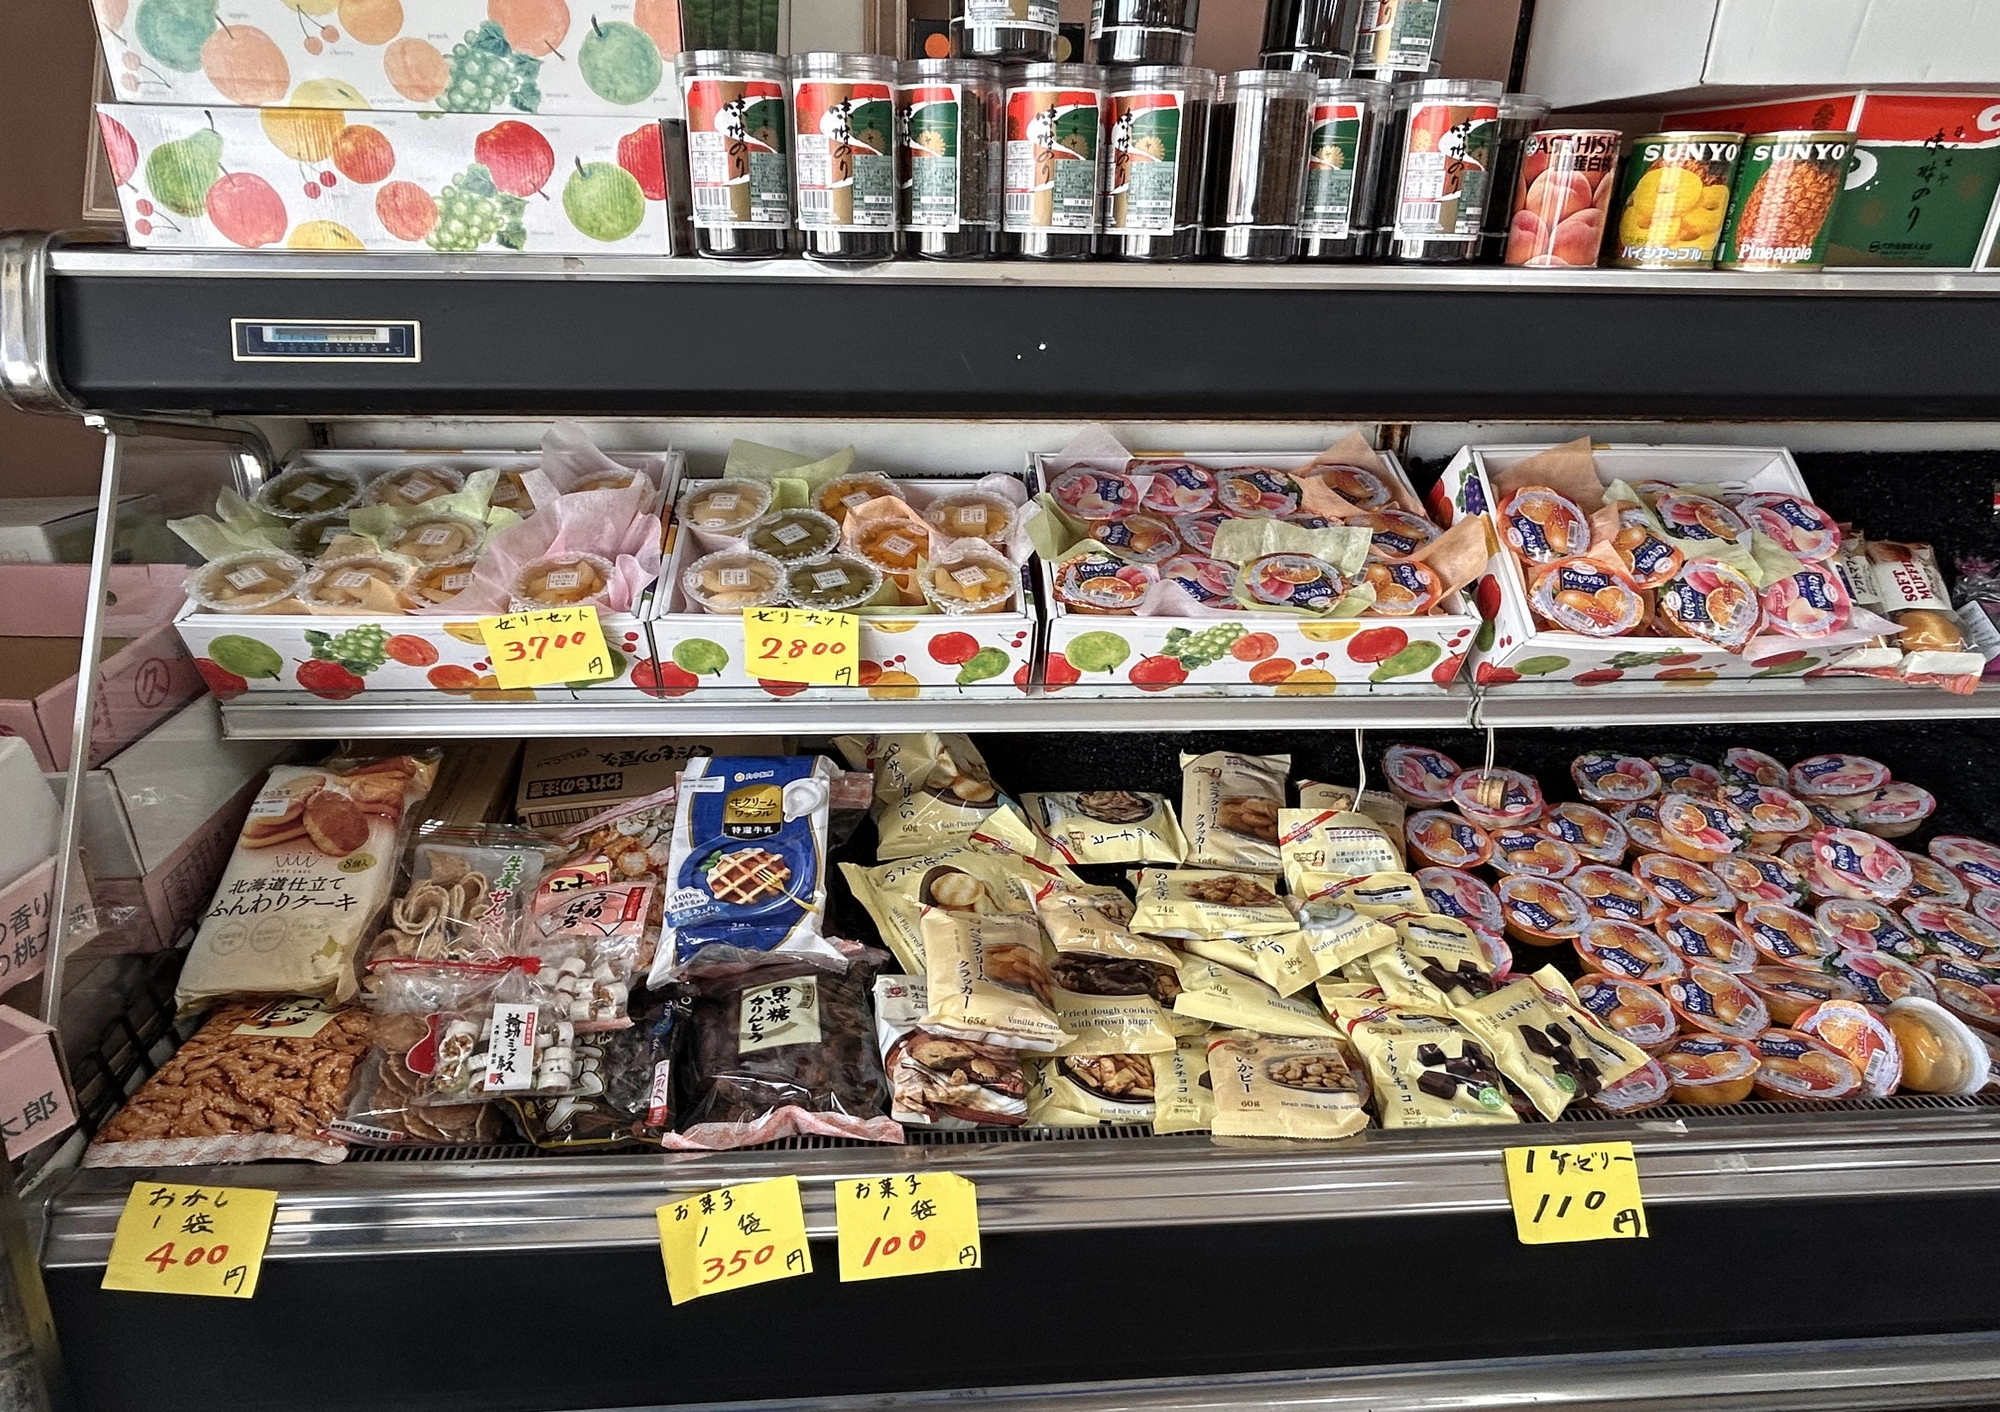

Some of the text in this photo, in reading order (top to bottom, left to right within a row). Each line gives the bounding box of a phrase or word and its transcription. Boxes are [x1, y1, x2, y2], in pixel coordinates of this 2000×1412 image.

[1643, 144, 1737, 161] SUNYO
[1753, 144, 1845, 161] SUNYO
[1738, 243, 1812, 263] Pineapple
[1893, 569, 1918, 602] SOFT
[495, 610, 588, 629] ゼリーセット
[752, 610, 849, 628] ゼリーセット
[589, 657, 603, 675] 円
[835, 667, 851, 686] 円
[735, 809, 773, 819] ワッフル
[731, 825, 773, 835] 特選牛乳
[1195, 813, 1206, 854] クラッカー
[229, 877, 346, 894] 北海道仕立て
[206, 893, 358, 919] ふんわりケーキ
[958, 960, 974, 1010] クラッカー
[766, 986, 791, 1022] 黒糖
[1062, 1006, 1159, 1018] Fried dough cookies
[748, 995, 765, 1044] かりんとう
[961, 1015, 988, 1026] 165g
[1008, 1015, 1035, 1027] Vanilla
[1070, 1018, 1091, 1028] with
[1241, 1100, 1261, 1108] 60g
[856, 1174, 921, 1199] お菓子
[148, 1187, 229, 1208] おかし
[674, 1190, 736, 1221] お菓子
[1532, 1190, 1641, 1237] 110 円
[863, 1229, 977, 1268] 100 円
[145, 1241, 247, 1294] 400 円
[702, 1245, 805, 1285] 350 円
